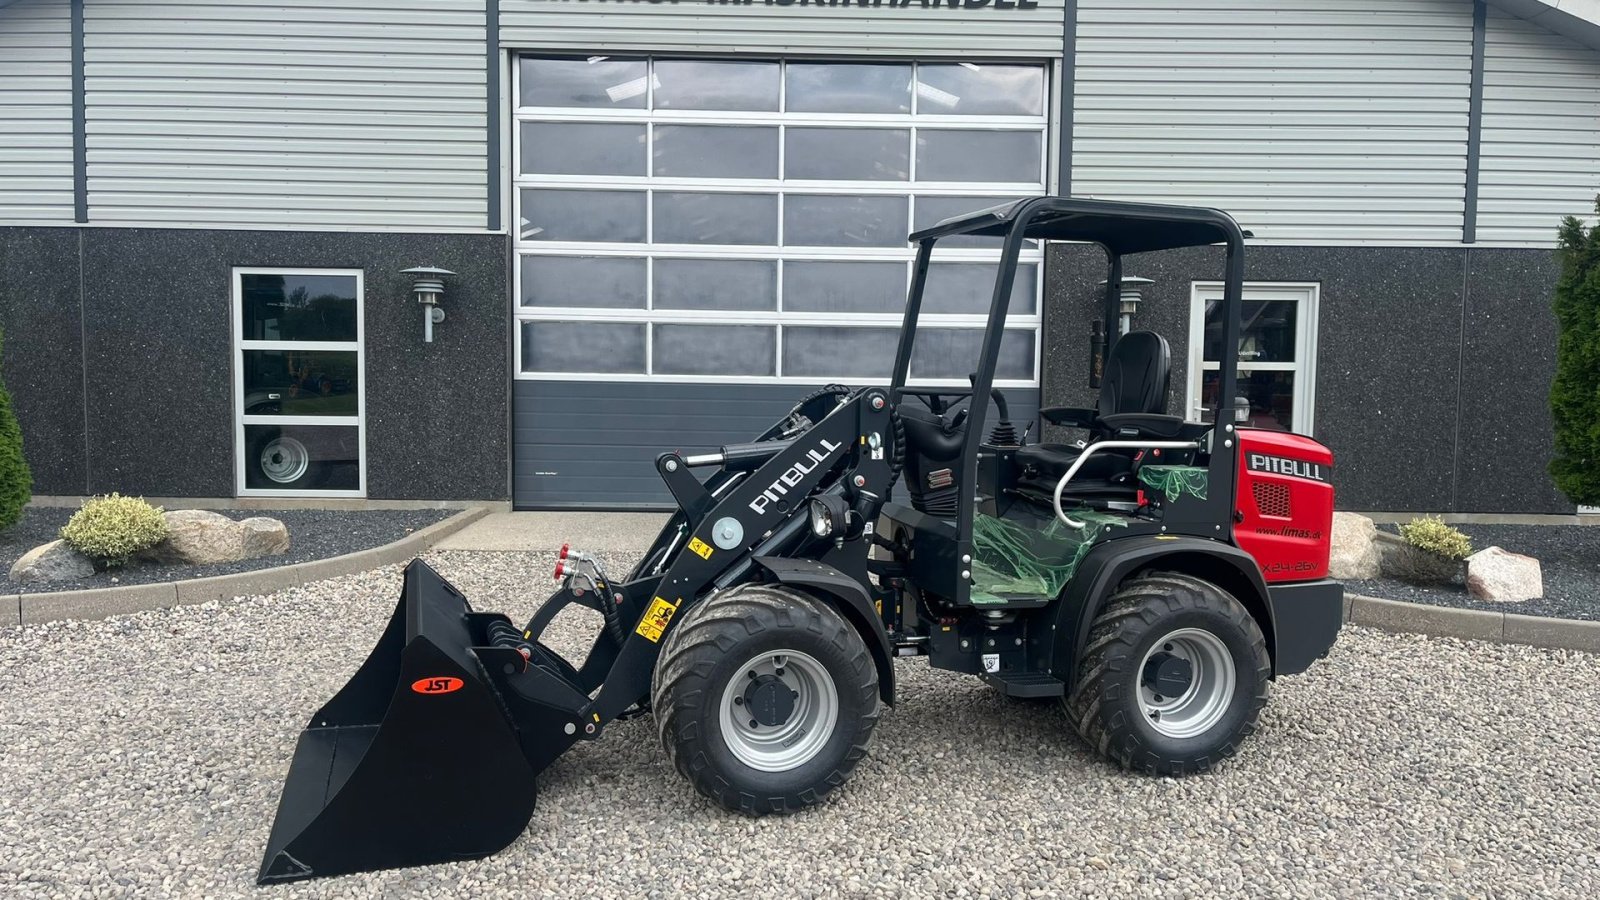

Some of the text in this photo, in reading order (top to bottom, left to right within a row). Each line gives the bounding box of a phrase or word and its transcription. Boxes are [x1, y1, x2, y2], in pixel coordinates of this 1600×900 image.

[749, 439, 842, 515] PITBULL
[1251, 454, 1324, 481] PITBULL
[1255, 525, 1322, 540] www.limas.dk
[424, 679, 452, 691] JST
